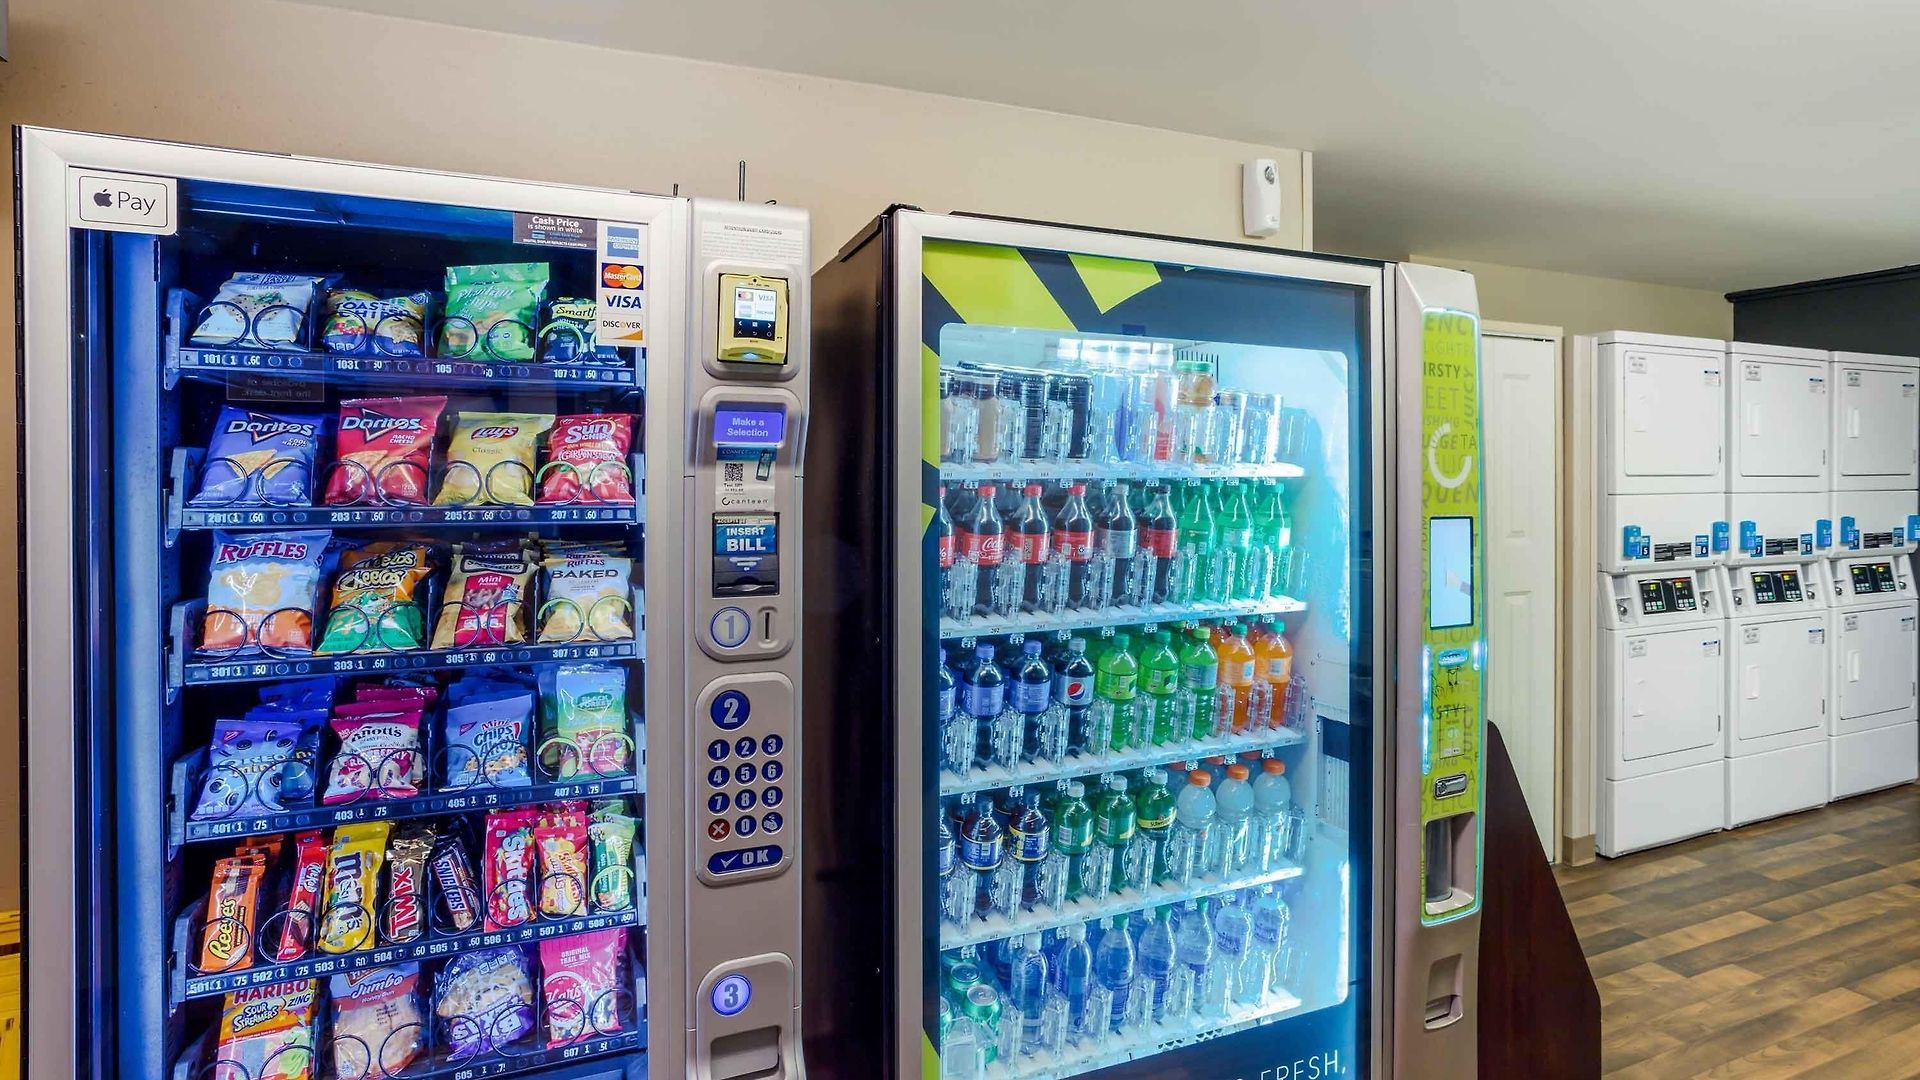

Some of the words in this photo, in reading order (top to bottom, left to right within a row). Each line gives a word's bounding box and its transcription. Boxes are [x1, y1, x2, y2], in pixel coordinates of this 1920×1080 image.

[118, 191, 156, 216] Pay
[532, 216, 554, 226] Cash
[556, 218, 580, 228] Price
[604, 272, 641, 281] MasterCard
[606, 295, 642, 309] VISA
[556, 306, 597, 318] Smartf
[602, 320, 640, 329] DISCOVER
[203, 354, 221, 364] 101
[436, 364, 451, 374] 105
[228, 420, 315, 437] Doritos
[342, 417, 420, 431] Doritos
[732, 418, 756, 426] Make
[565, 424, 609, 443] Sun
[727, 428, 768, 437] Selection
[208, 513, 226, 522] 201
[250, 512, 263, 522] .60
[331, 512, 349, 522] 203
[371, 512, 384, 521] .60
[445, 511, 463, 520] 205
[482, 511, 494, 520] .60
[552, 510, 566, 520] 207
[585, 510, 596, 520] .60
[727, 528, 766, 536] INSERT
[727, 538, 766, 551] BILL
[1643, 547, 1648, 555] 5
[216, 541, 308, 564] RUFFLES
[567, 559, 605, 568] RUFFLES
[552, 570, 619, 578] BAKED
[724, 615, 734, 640] 1
[446, 654, 464, 664] 305
[484, 653, 495, 662] .60
[553, 649, 568, 657] 307
[587, 648, 598, 656] .60
[212, 667, 230, 677] 301
[253, 665, 266, 675] .60
[334, 661, 352, 670] 303
[373, 659, 385, 668] .60
[723, 698, 739, 724] 2
[482, 719, 510, 730] Mini
[714, 744, 721, 757] 1
[741, 741, 750, 754] 2
[768, 739, 776, 752] 3
[713, 770, 722, 783] 4
[741, 767, 749, 780] 5
[768, 765, 776, 778] 6
[554, 788, 569, 797] 407
[588, 786, 598, 794] .75
[448, 799, 465, 808] 405
[485, 795, 497, 804] .75
[715, 796, 722, 809] 7
[741, 793, 749, 806] 8
[768, 790, 776, 803] 9
[335, 811, 353, 821] 403
[375, 808, 387, 816] .75
[212, 824, 231, 834] 401
[253, 820, 267, 829] .75
[741, 819, 749, 832] 0
[742, 850, 769, 865] OK
[435, 860, 466, 911] SNICKERS
[389, 866, 416, 938] TWIX
[208, 899, 236, 960] Reese's
[540, 926, 555, 936] 507
[572, 922, 582, 931] .60
[430, 943, 447, 953] 505
[469, 937, 480, 947] .60
[374, 952, 392, 962] 504
[414, 946, 425, 956] .60
[561, 947, 588, 957] ORIGINAL
[315, 962, 334, 972] 503
[560, 956, 576, 965] TRAIL
[235, 978, 247, 986] .75
[252, 972, 272, 982] 502
[234, 981, 311, 1004] HARIBO
[351, 973, 404, 999] Jumbo
[288, 993, 311, 1008] ZING
[724, 984, 739, 1008] 3
[244, 1002, 266, 1018] SOUR
[232, 1008, 278, 1032] STREAMERS
